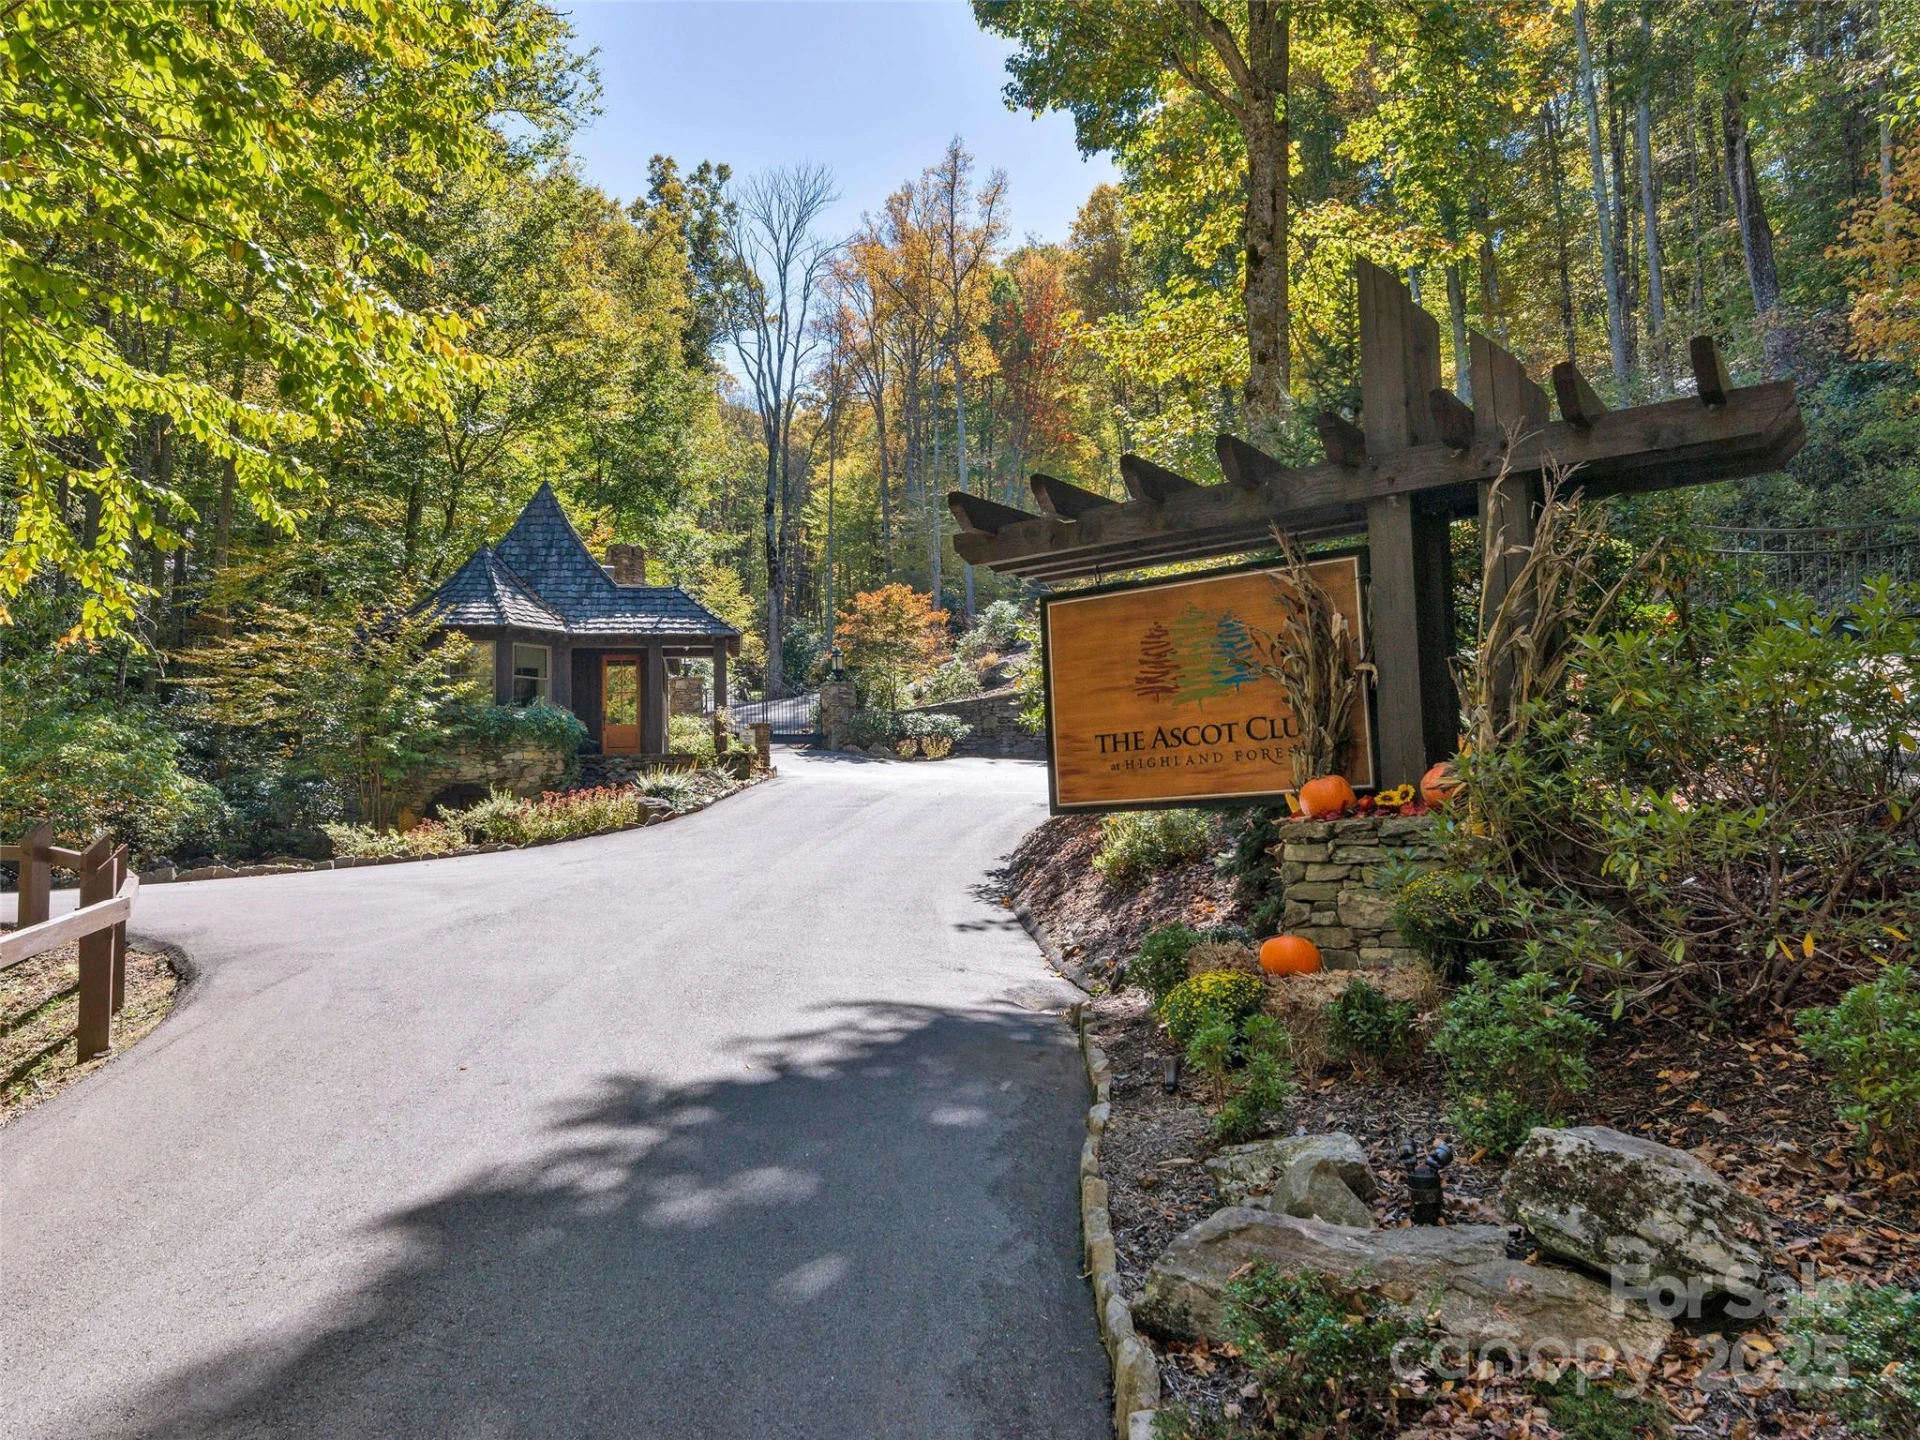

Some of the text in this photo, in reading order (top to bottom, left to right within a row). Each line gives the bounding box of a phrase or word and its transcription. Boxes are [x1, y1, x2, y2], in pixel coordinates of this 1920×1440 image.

[1094, 716, 1302, 754] THE ASCOT CLU
[1110, 762, 1120, 771] at
[1125, 752, 1224, 770] HIGHLAND
